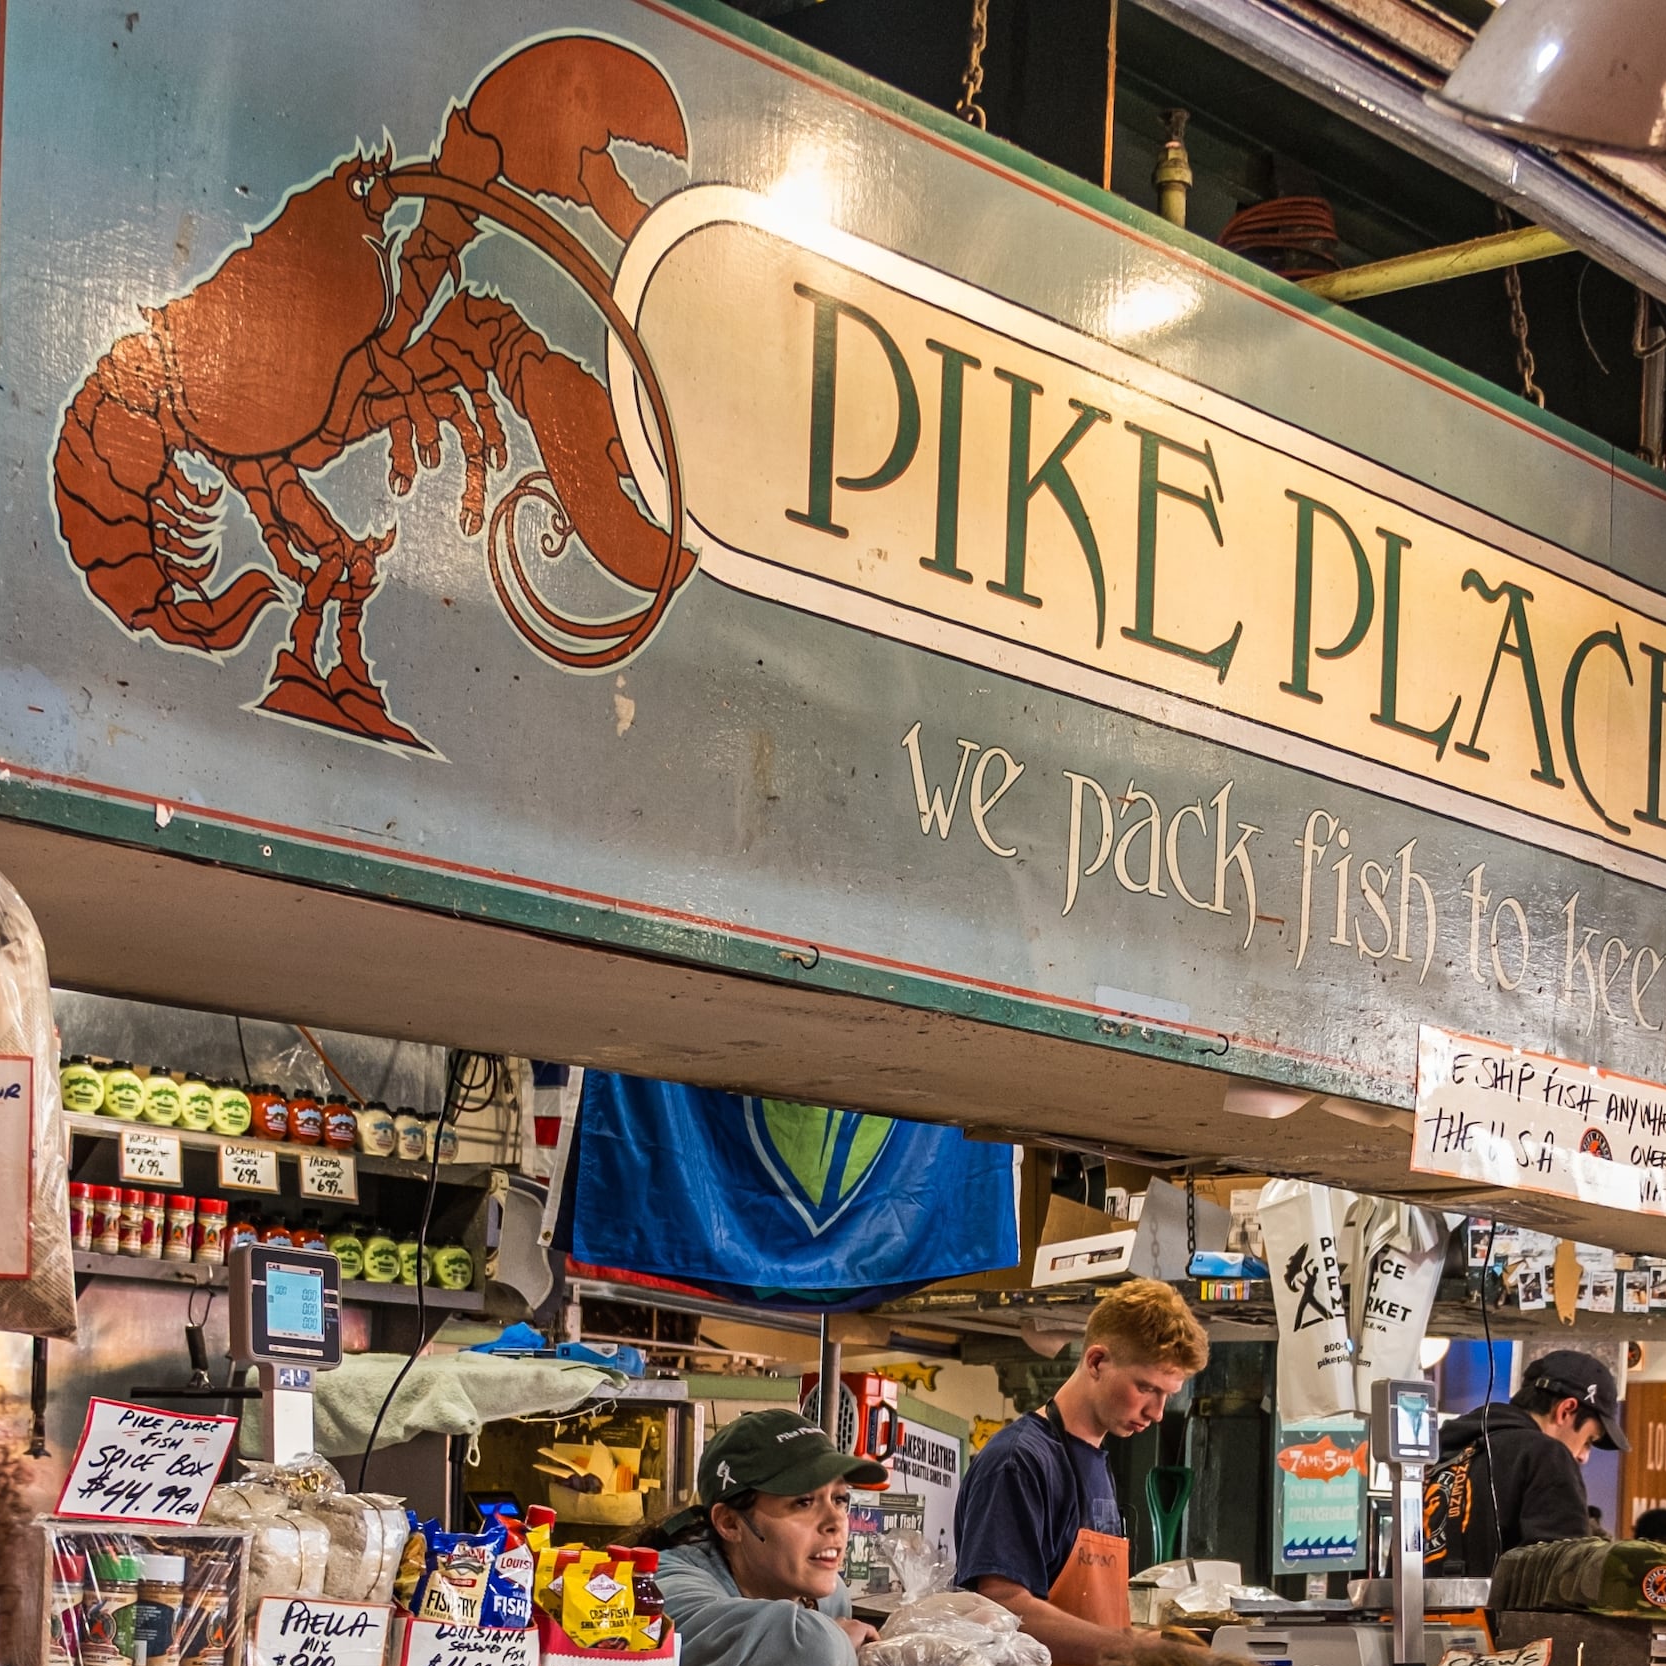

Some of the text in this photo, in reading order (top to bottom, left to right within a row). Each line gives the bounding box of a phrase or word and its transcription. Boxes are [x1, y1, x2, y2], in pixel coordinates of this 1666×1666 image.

[785, 281, 1242, 685] PIKE
[901, 721, 1025, 858] we
[1061, 779, 1264, 949] pack
[1294, 809, 1437, 985] fish
[1464, 862, 1530, 993] to
[1475, 1057, 1535, 1104] SHIP
[1543, 1067, 1600, 1121] FISH
[1424, 1107, 1482, 1154] THE
[118, 1410, 220, 1433] PIKE PLACE
[141, 1432, 184, 1450] FISH
[928, 1441, 956, 1474] LEATHER
[89, 1445, 214, 1478] SPICE BOX
[78, 1470, 191, 1515] $44.99
[280, 1600, 379, 1639] PAELLA
[493, 1594, 528, 1617] FISH
[300, 1638, 331, 1654] MIX
[434, 1624, 526, 1644] LOUISIANA
